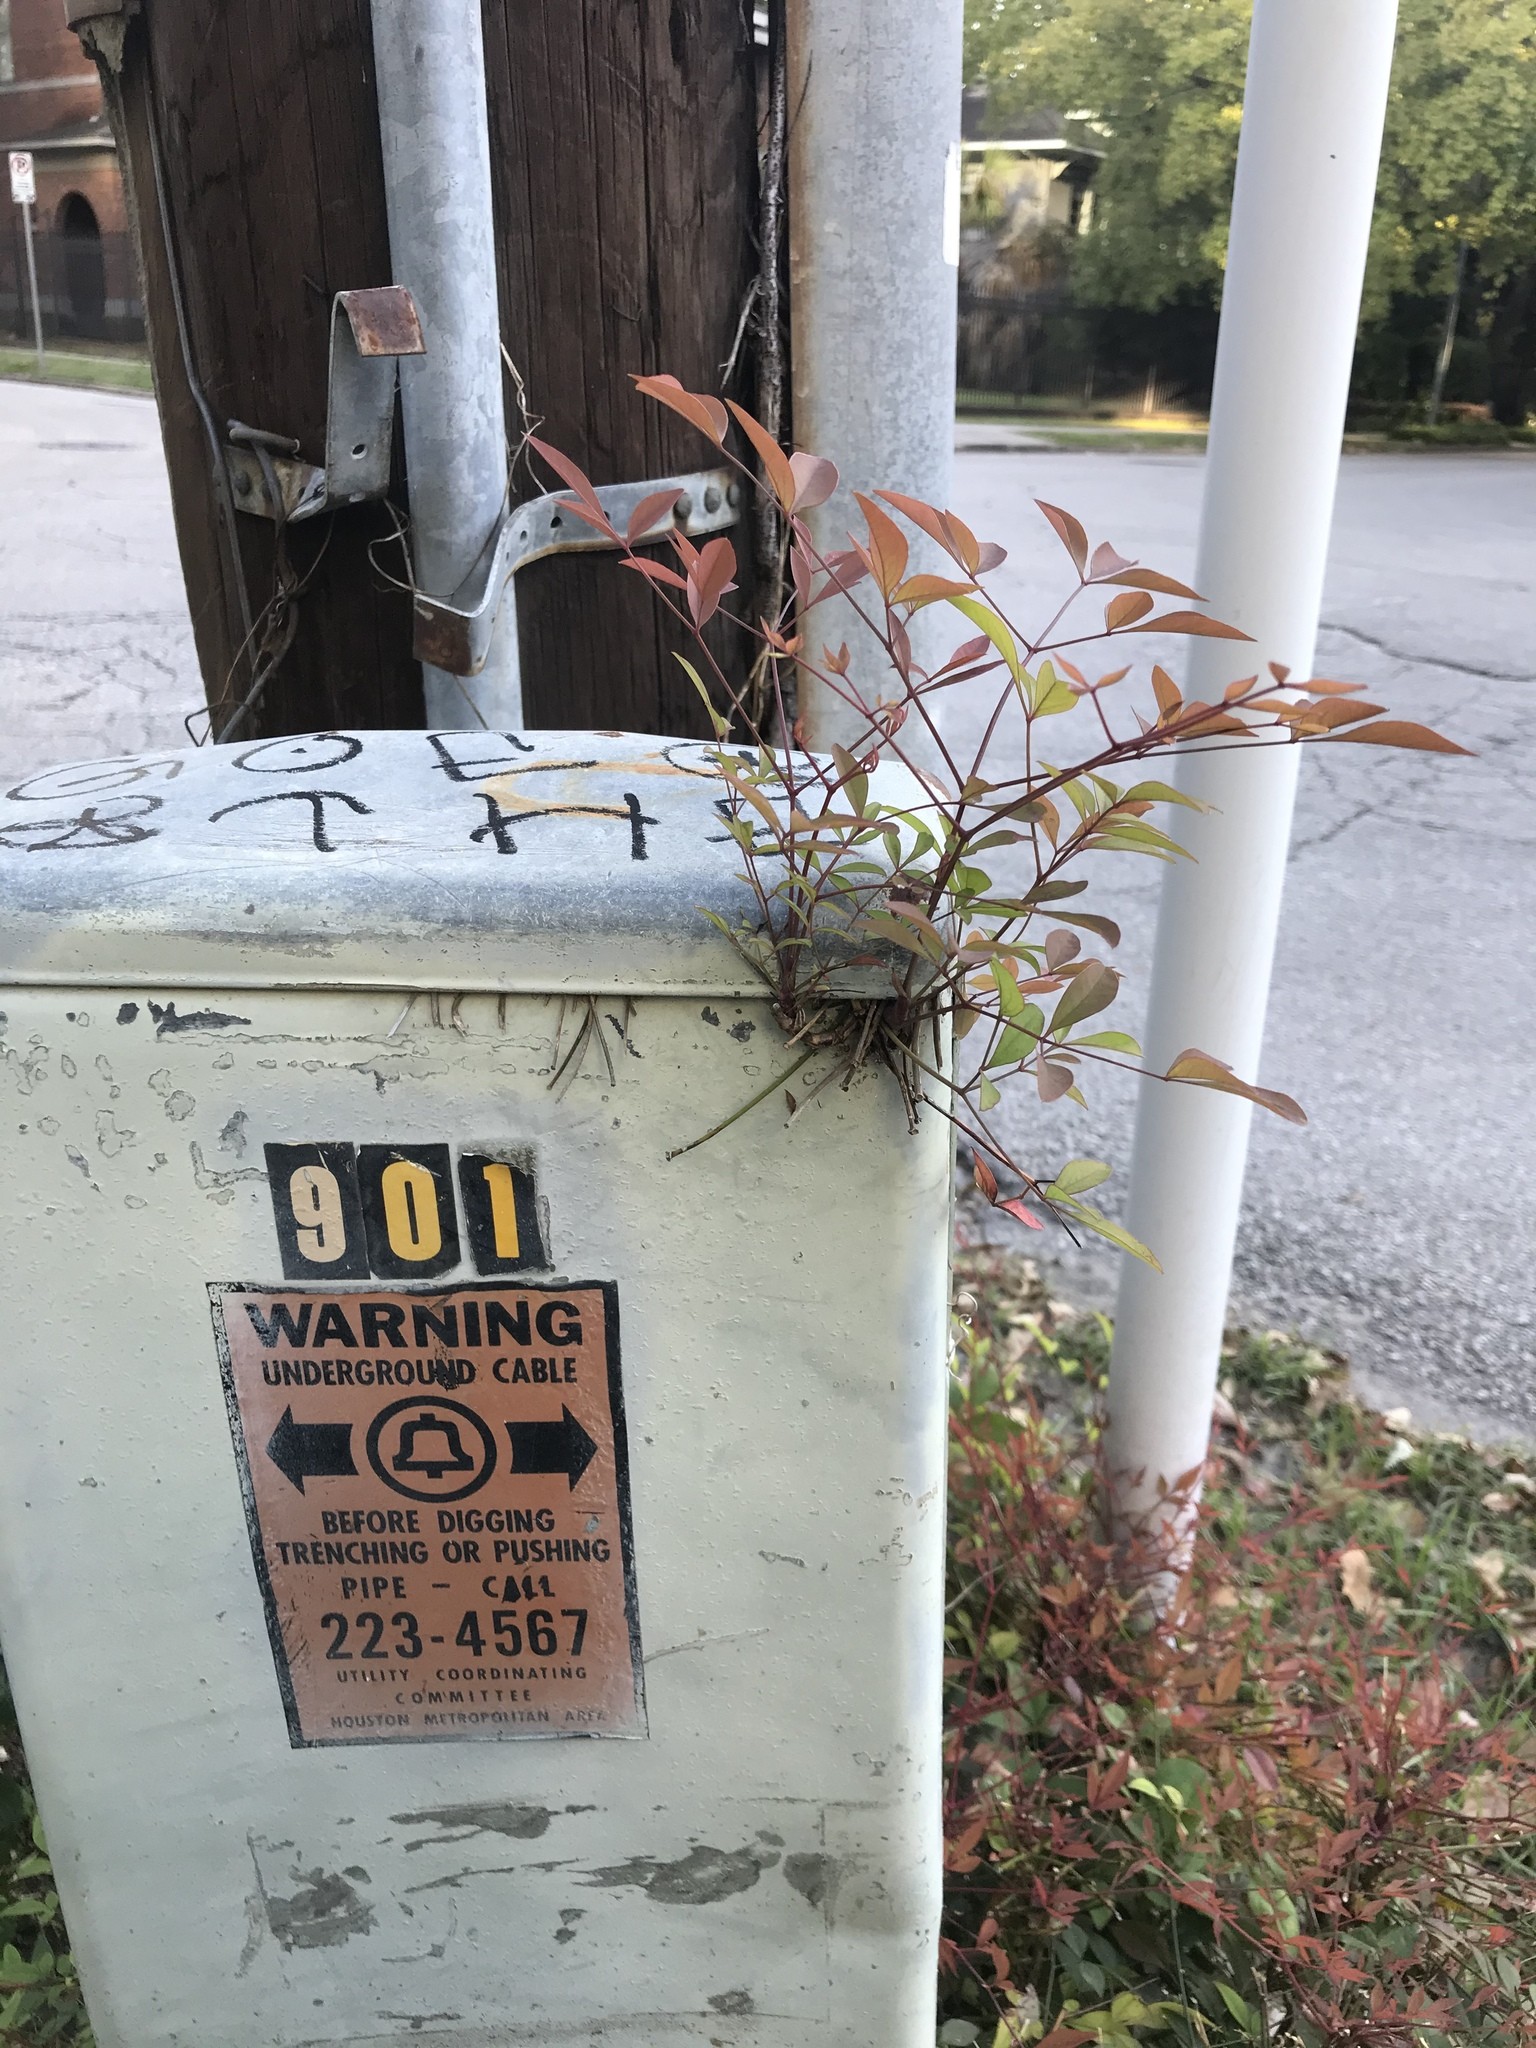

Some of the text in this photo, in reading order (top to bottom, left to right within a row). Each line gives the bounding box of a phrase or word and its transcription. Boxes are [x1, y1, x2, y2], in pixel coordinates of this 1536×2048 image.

[289, 1161, 520, 1262] 901
[244, 1301, 583, 1348] WARNING
[262, 1357, 578, 1390] UNDERGROUND CABLE
[322, 1509, 555, 1534] BEFORE DIGGING
[276, 1539, 610, 1566] TRENCHING OR PUSHING
[341, 1577, 406, 1599] PIPE
[483, 1575, 556, 1602] CALL
[321, 1609, 588, 1660] 223-4567
[336, 1667, 587, 1683] UTILITY COORDINATING
[395, 1690, 532, 1705] COMMITTEE
[330, 1715, 410, 1728] HOUSTON
[424, 1711, 550, 1726] METROPOLITAN
